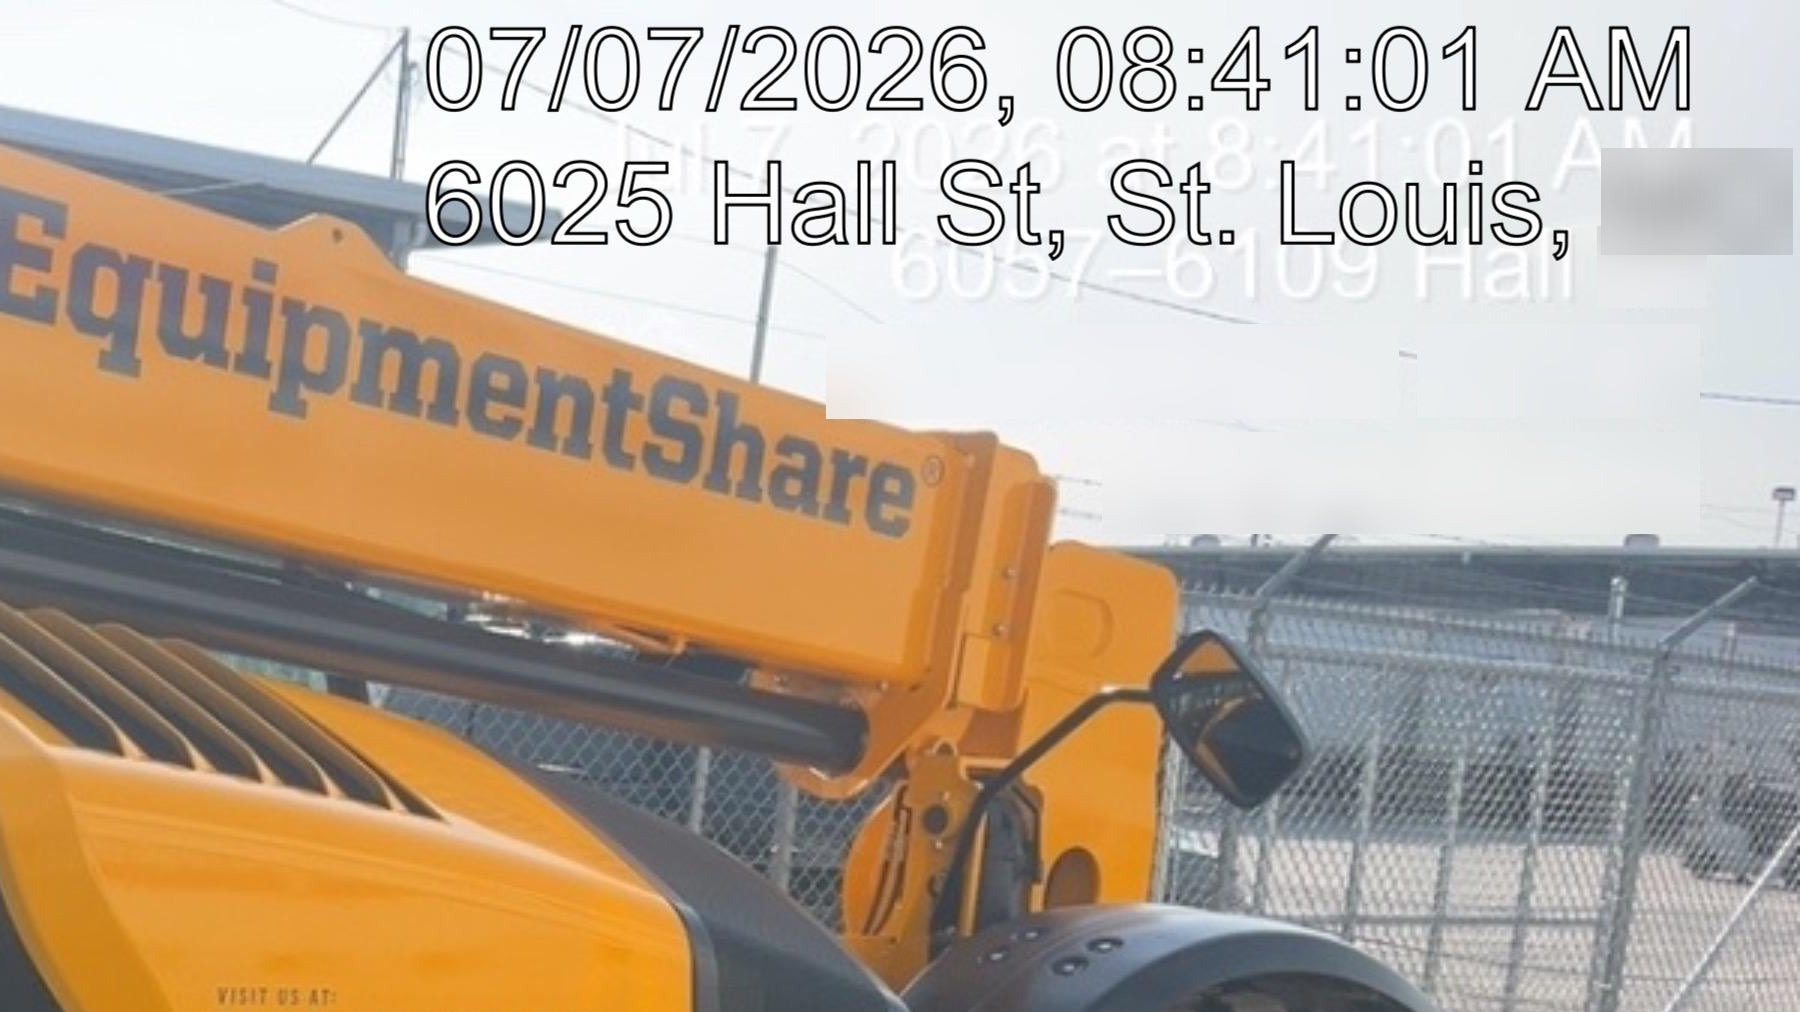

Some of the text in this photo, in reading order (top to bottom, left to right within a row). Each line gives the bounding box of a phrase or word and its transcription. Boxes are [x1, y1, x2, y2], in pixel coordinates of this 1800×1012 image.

[217, 986, 337, 1006] VISIT US AT:
